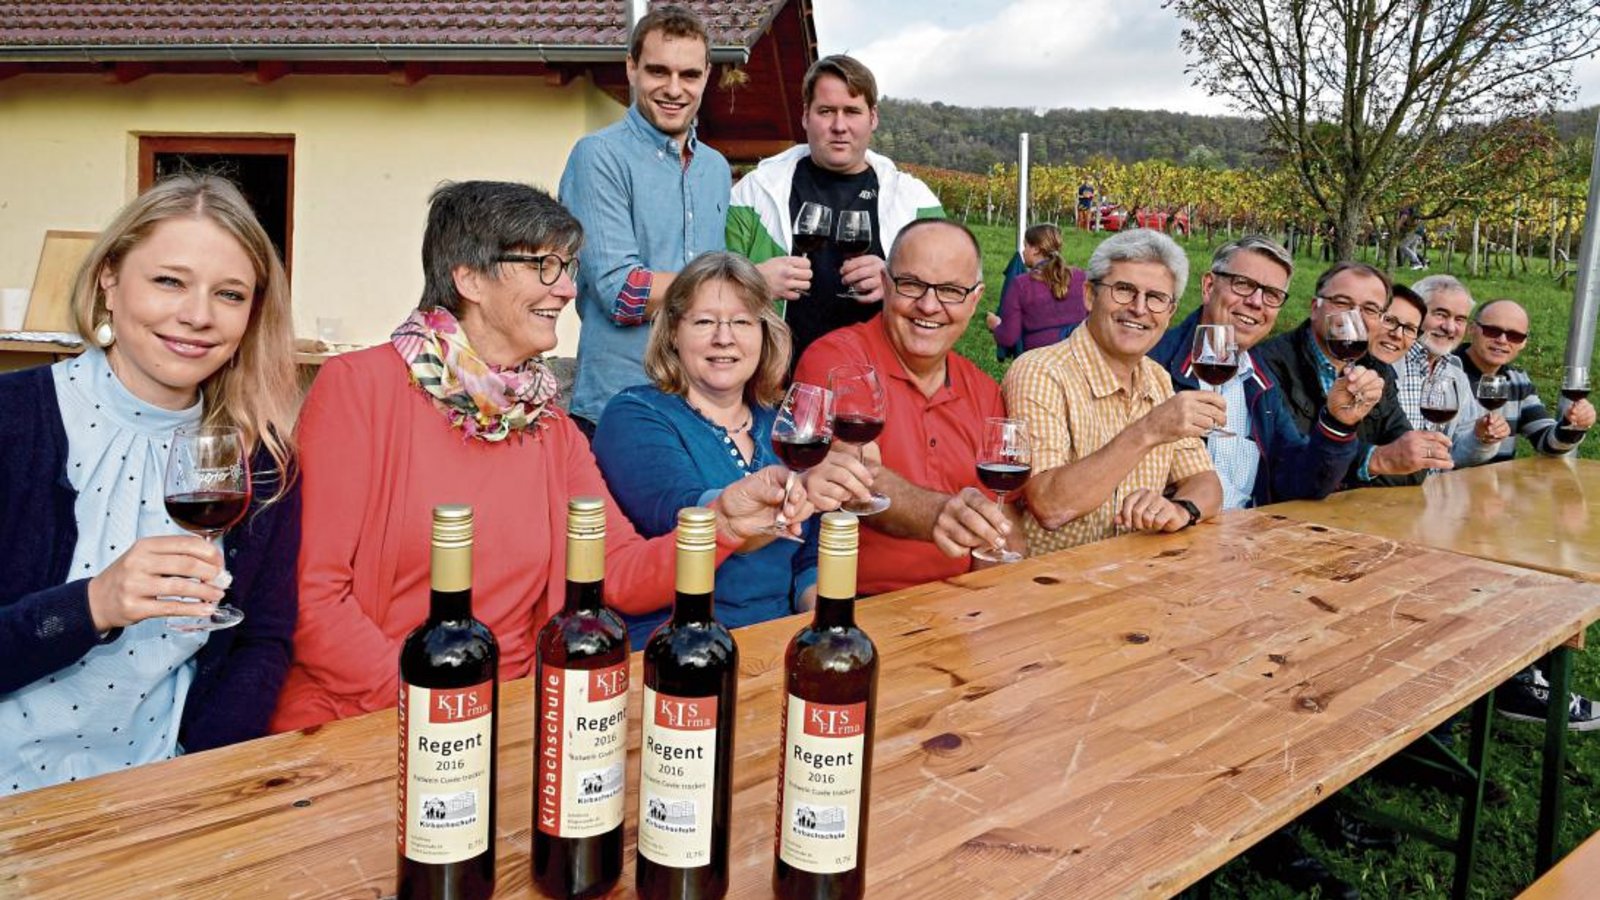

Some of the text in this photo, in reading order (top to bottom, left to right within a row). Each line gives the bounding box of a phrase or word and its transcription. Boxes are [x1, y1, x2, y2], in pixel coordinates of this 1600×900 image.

[577, 707, 627, 732] Regent
[418, 733, 483, 756] Regent
[542, 674, 559, 828] Kirbachschule
[594, 734, 617, 747] 2016
[647, 736, 704, 760] Regent
[436, 760, 465, 771] 2016
[794, 745, 854, 769] Regent
[658, 764, 684, 777] 2016
[808, 772, 835, 784] 2016
